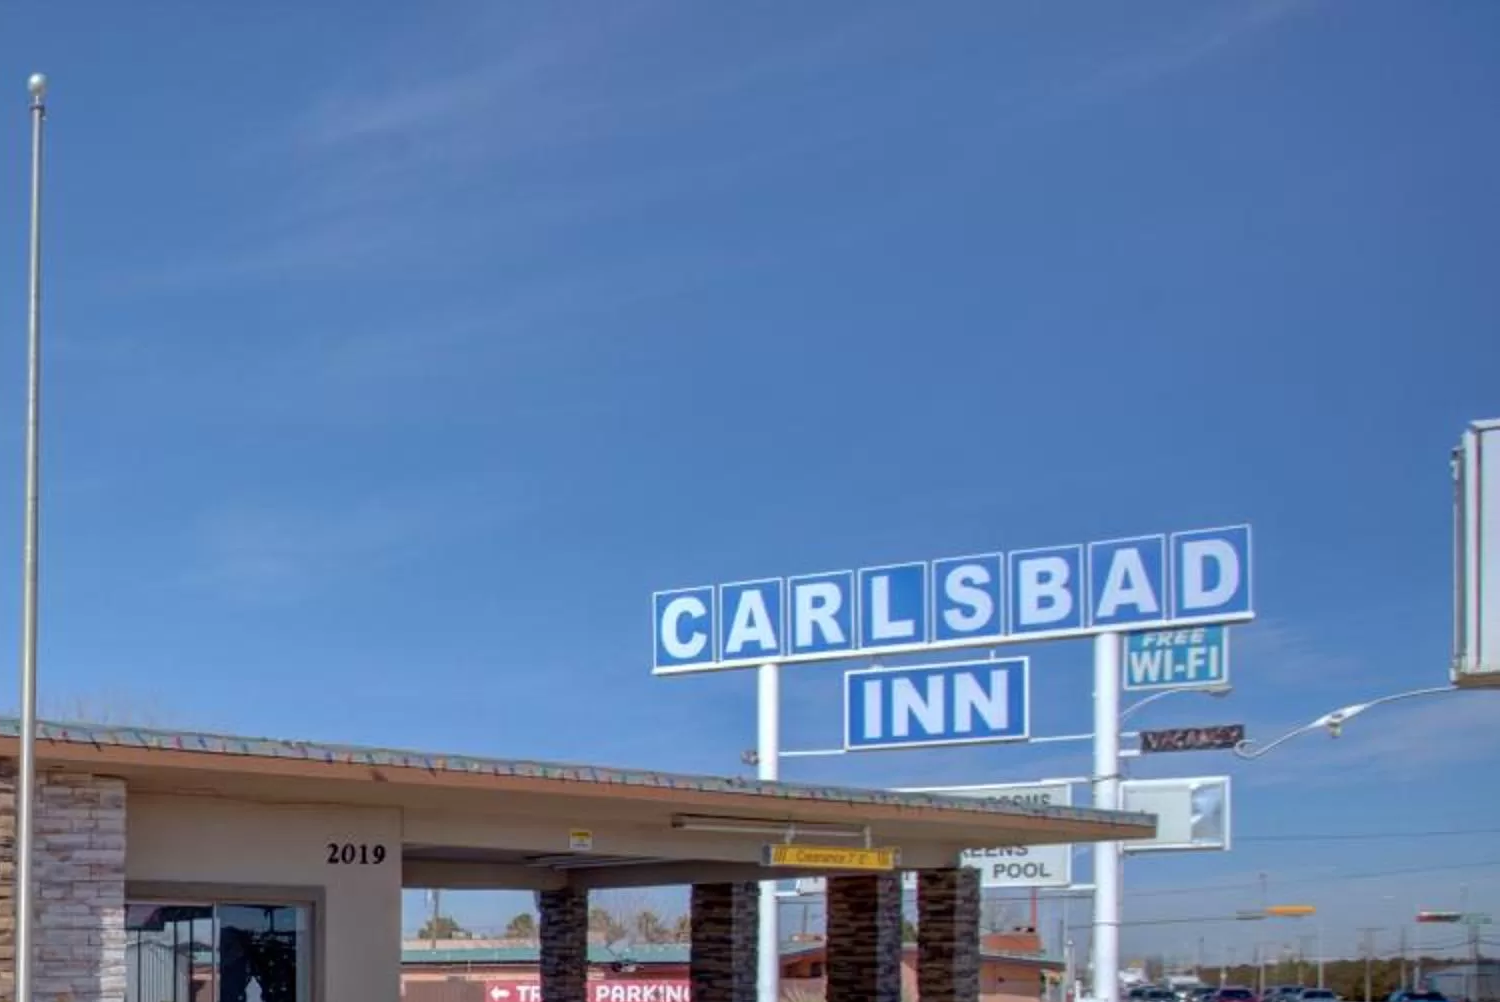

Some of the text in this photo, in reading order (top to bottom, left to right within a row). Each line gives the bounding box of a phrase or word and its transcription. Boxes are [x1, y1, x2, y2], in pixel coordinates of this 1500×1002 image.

[660, 539, 1240, 659] CARLSBAD
[1140, 627, 1205, 647] FREE
[1130, 645, 1218, 683] WI-FI
[863, 669, 1009, 739] INN
[326, 843, 386, 864] 2019
[993, 862, 1052, 879] POOL
